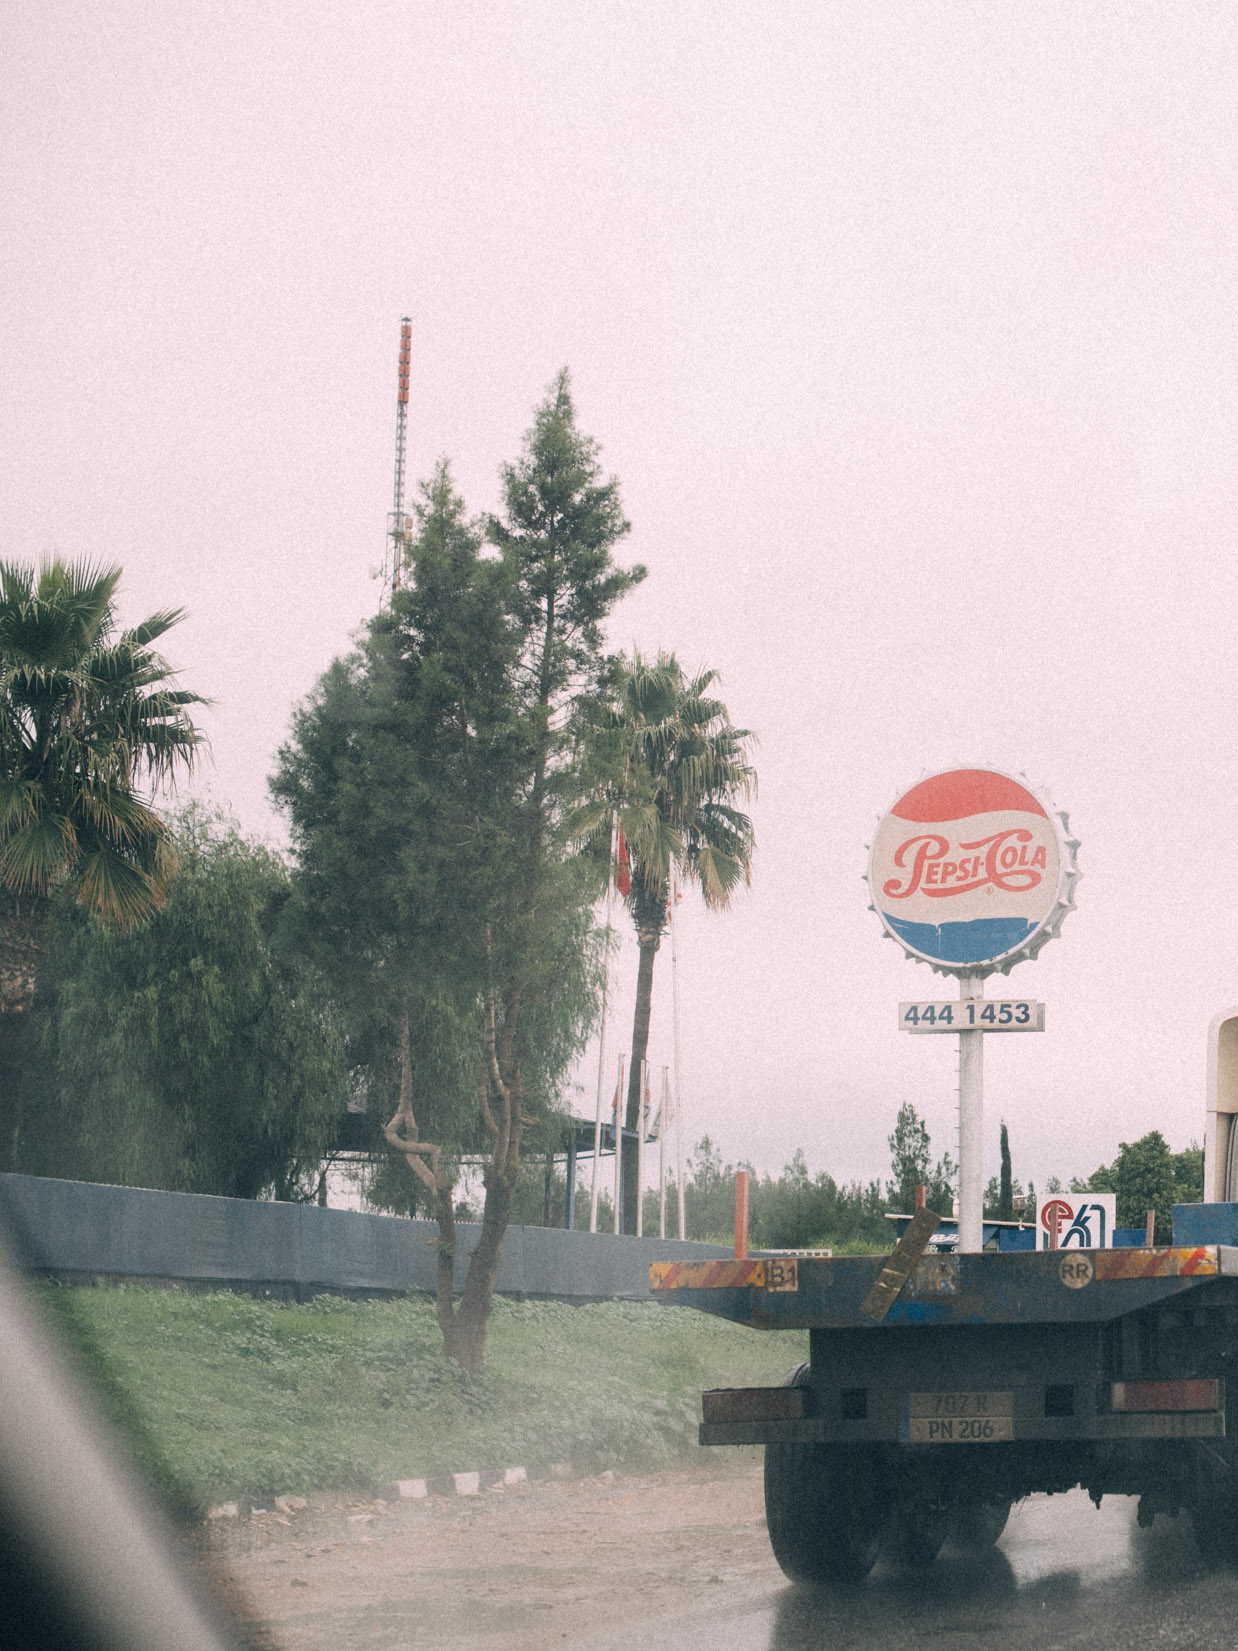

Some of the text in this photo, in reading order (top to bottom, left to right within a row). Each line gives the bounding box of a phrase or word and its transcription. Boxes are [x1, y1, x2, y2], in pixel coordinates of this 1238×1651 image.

[904, 1003, 1030, 1025] 444 1453
[1062, 1263, 1089, 1279] RR
[928, 1421, 994, 1439] PN 206
